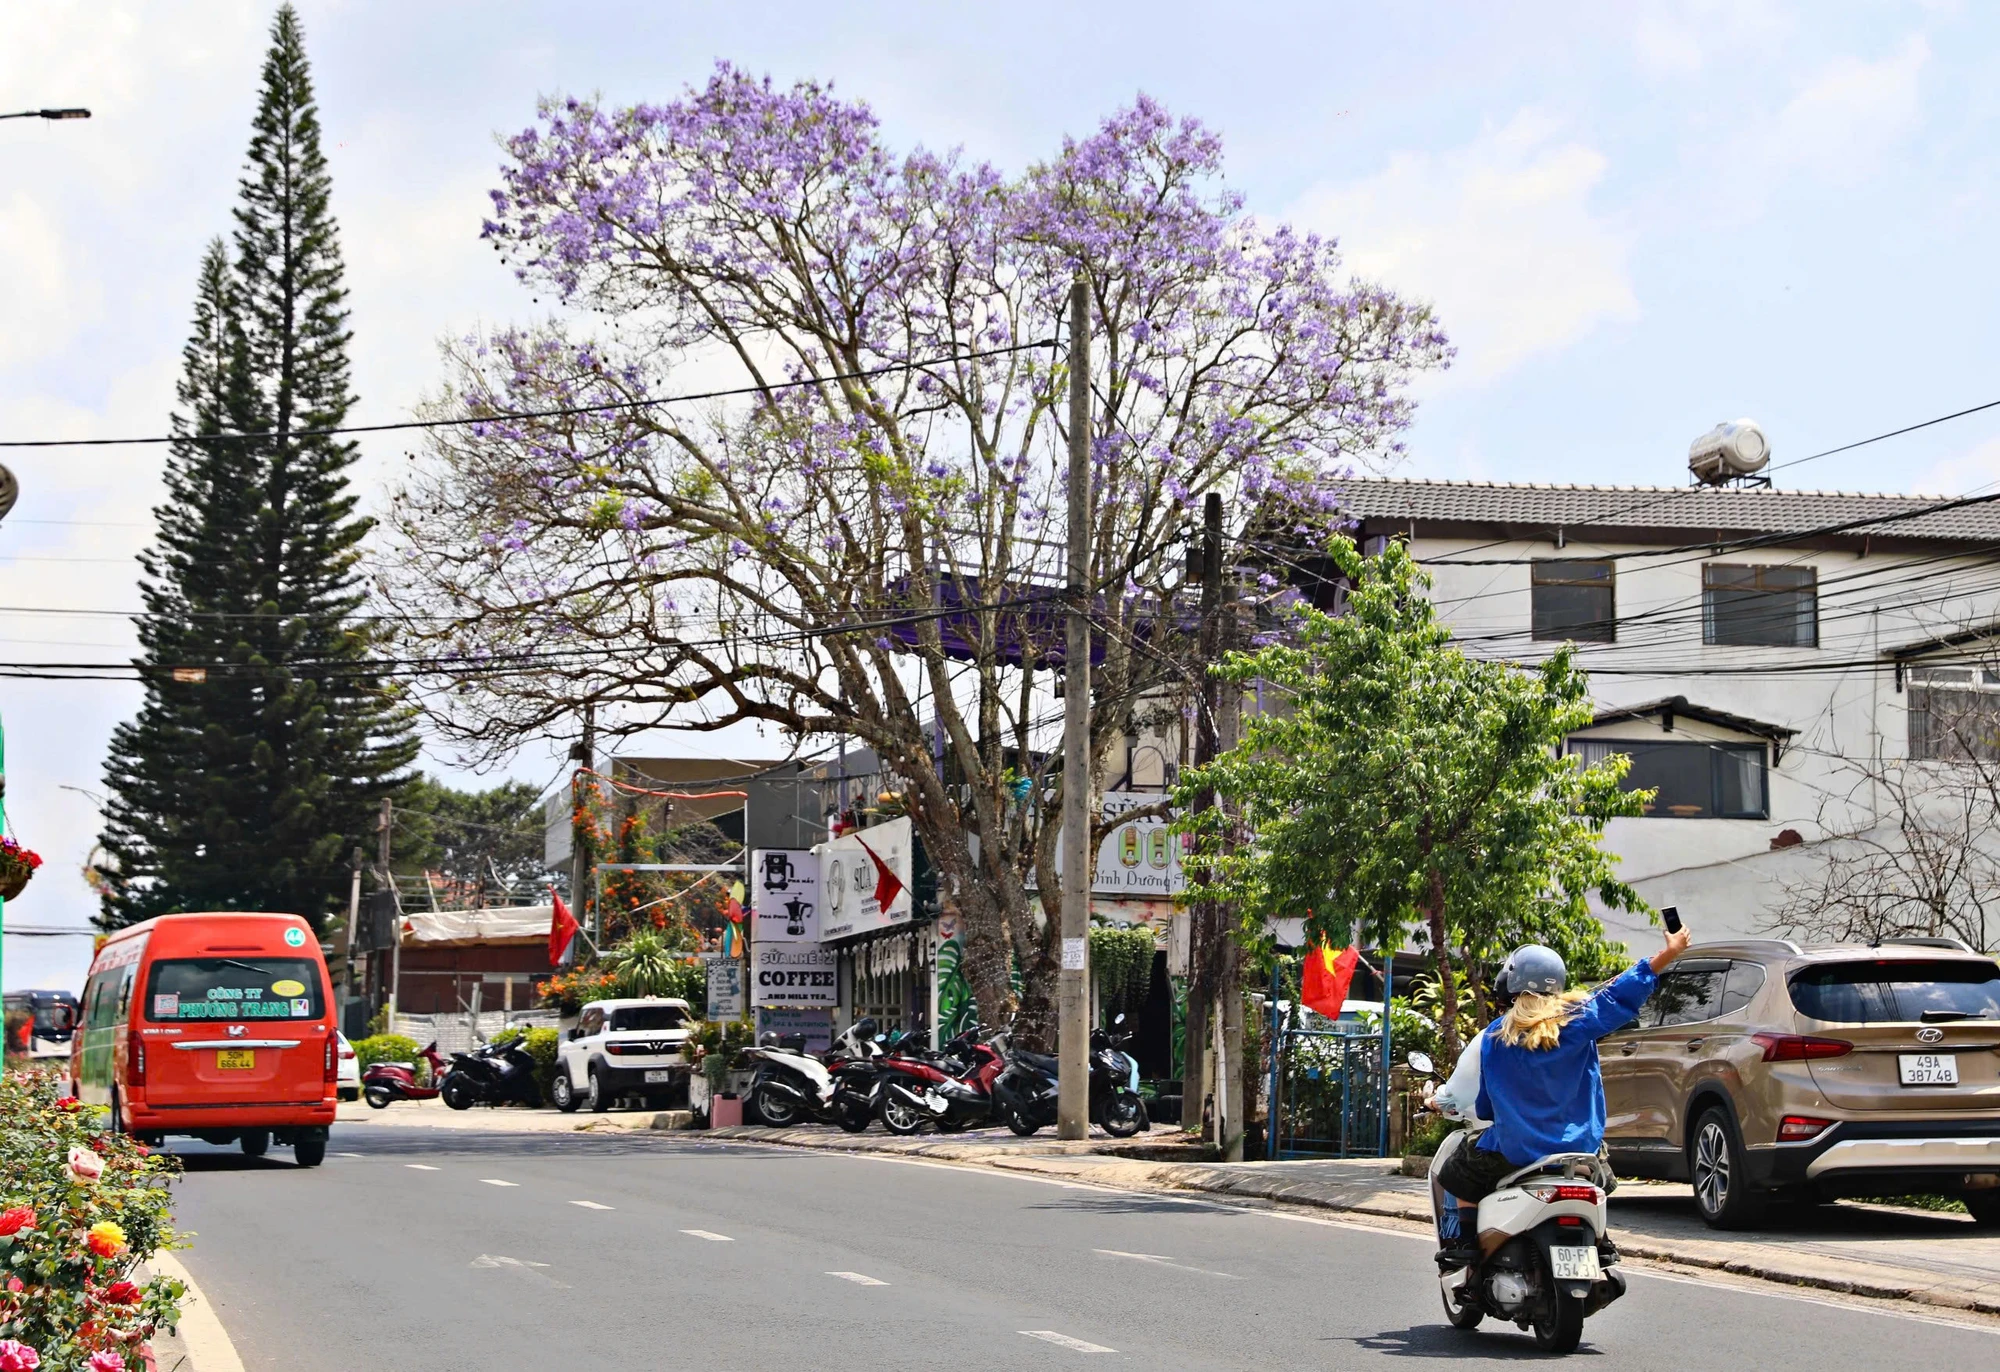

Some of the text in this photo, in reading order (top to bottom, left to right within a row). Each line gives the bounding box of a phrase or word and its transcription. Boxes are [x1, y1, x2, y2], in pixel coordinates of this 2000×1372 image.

[758, 970, 835, 987] COFFEE
[207, 986, 263, 1000] CÔNG TY
[241, 1002, 290, 1017] TRANG
[1917, 1056, 1941, 1068] 49A
[1908, 1070, 1952, 1082] 387.48
[1557, 1248, 1591, 1262] 60-F1
[1555, 1263, 1598, 1278] 254.31
